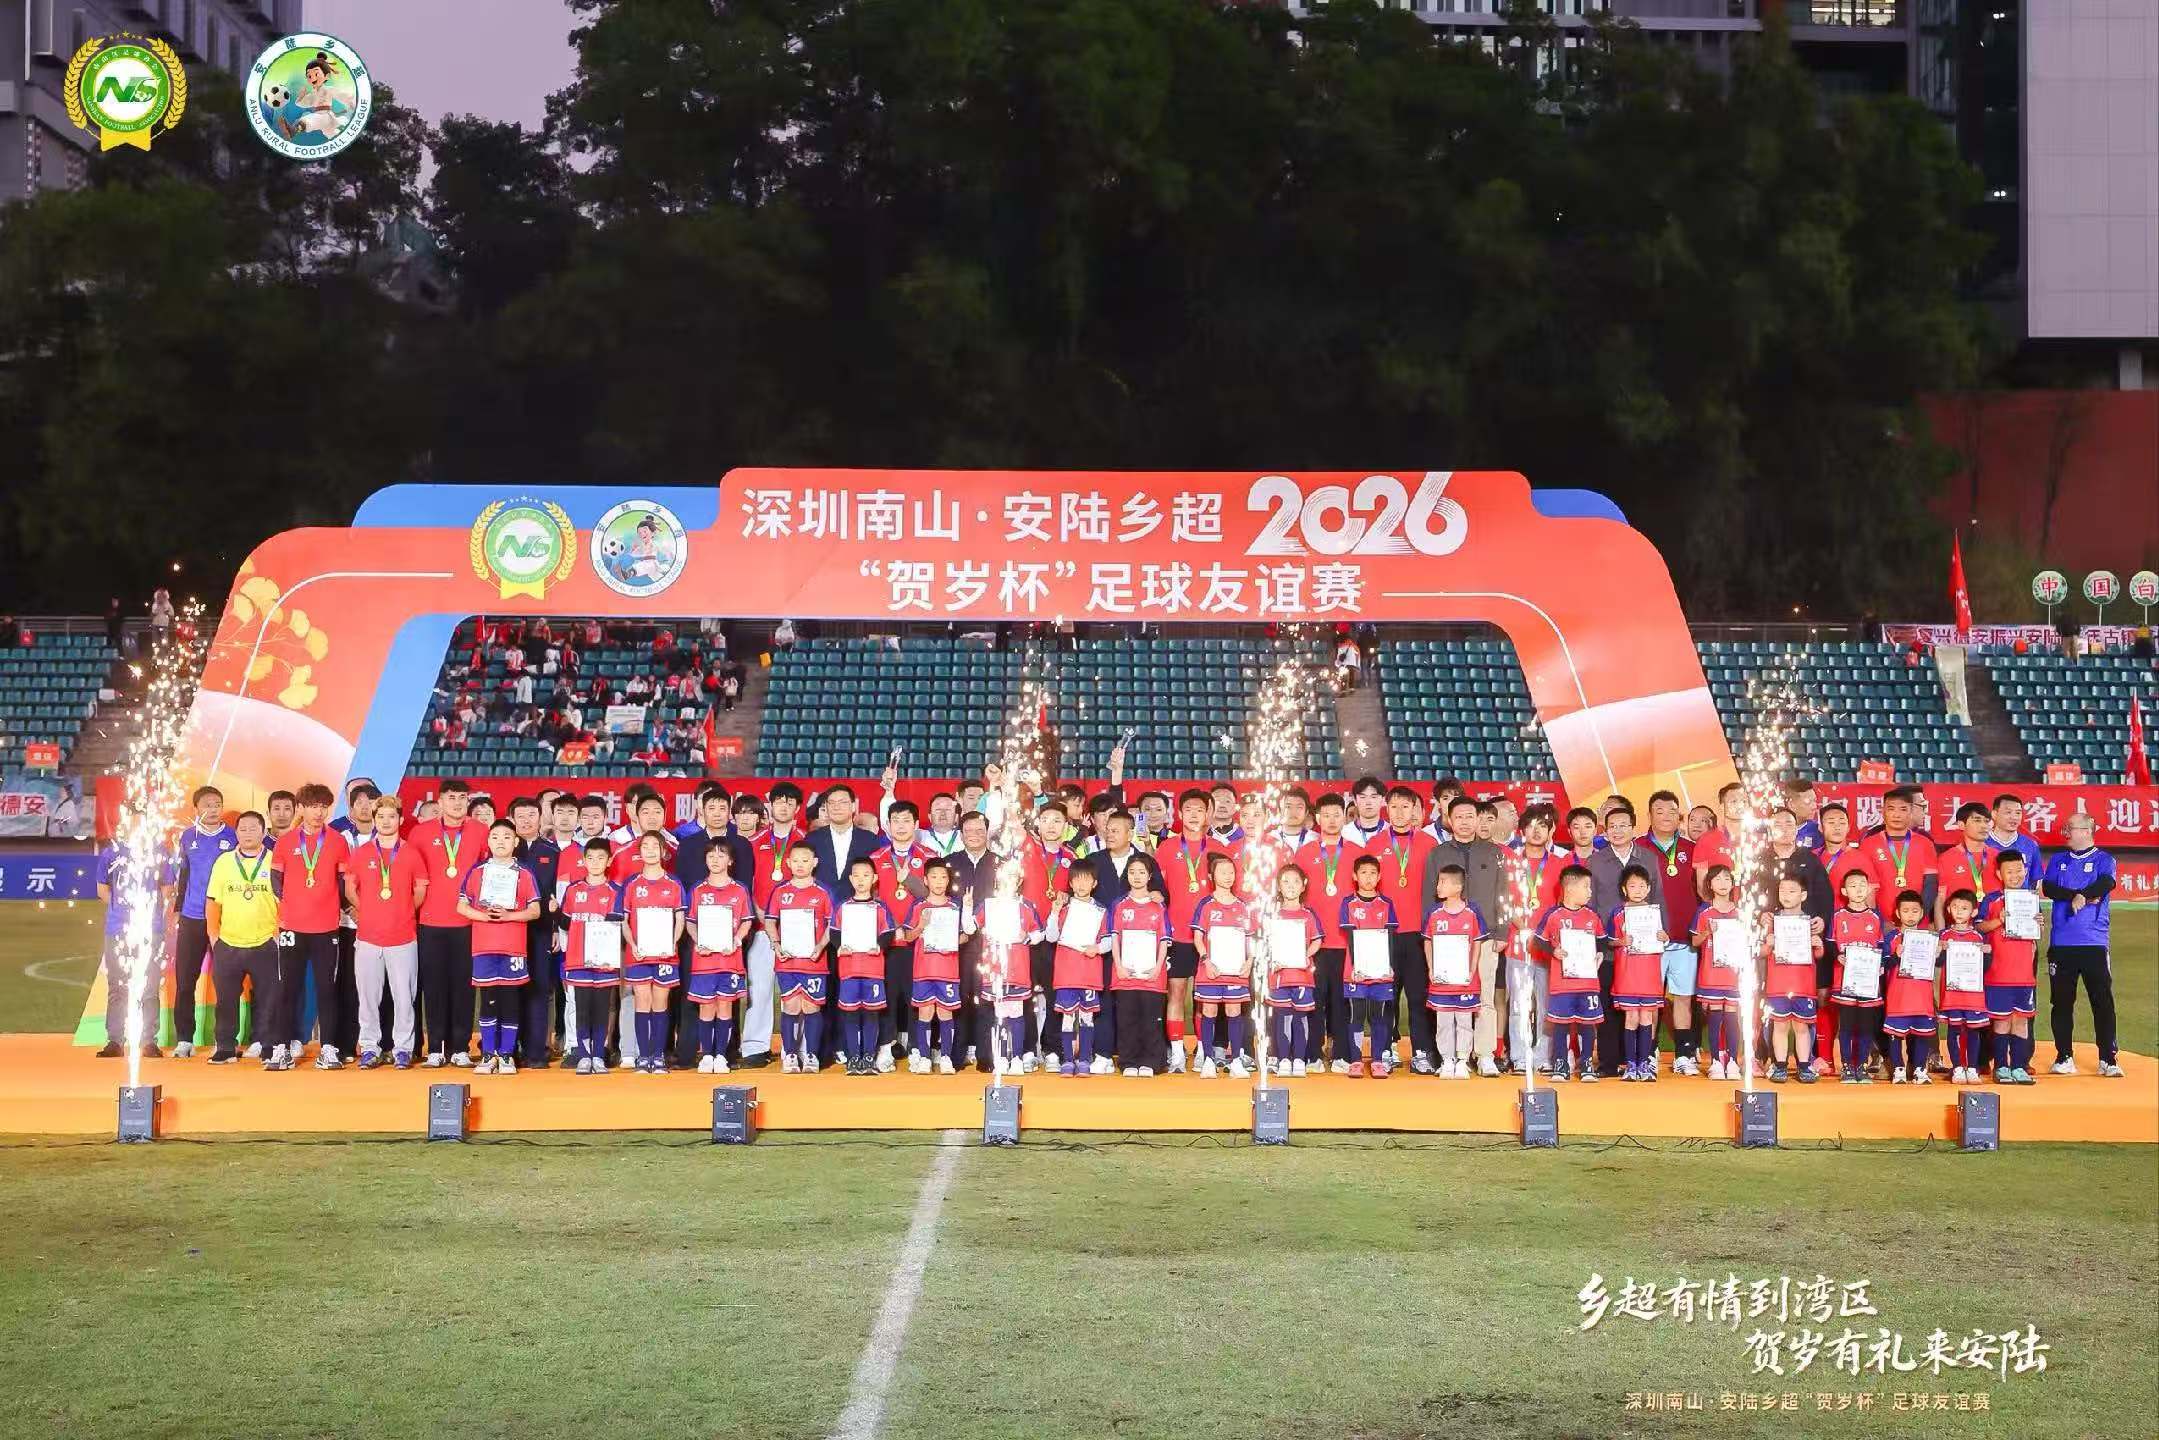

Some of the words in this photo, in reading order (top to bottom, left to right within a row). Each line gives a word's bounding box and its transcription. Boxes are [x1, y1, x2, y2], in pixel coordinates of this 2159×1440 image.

[741, 487, 1223, 543] 深圳南山·安陆乡超
[1244, 471, 1468, 556] 2026
[945, 984, 954, 998] 5
